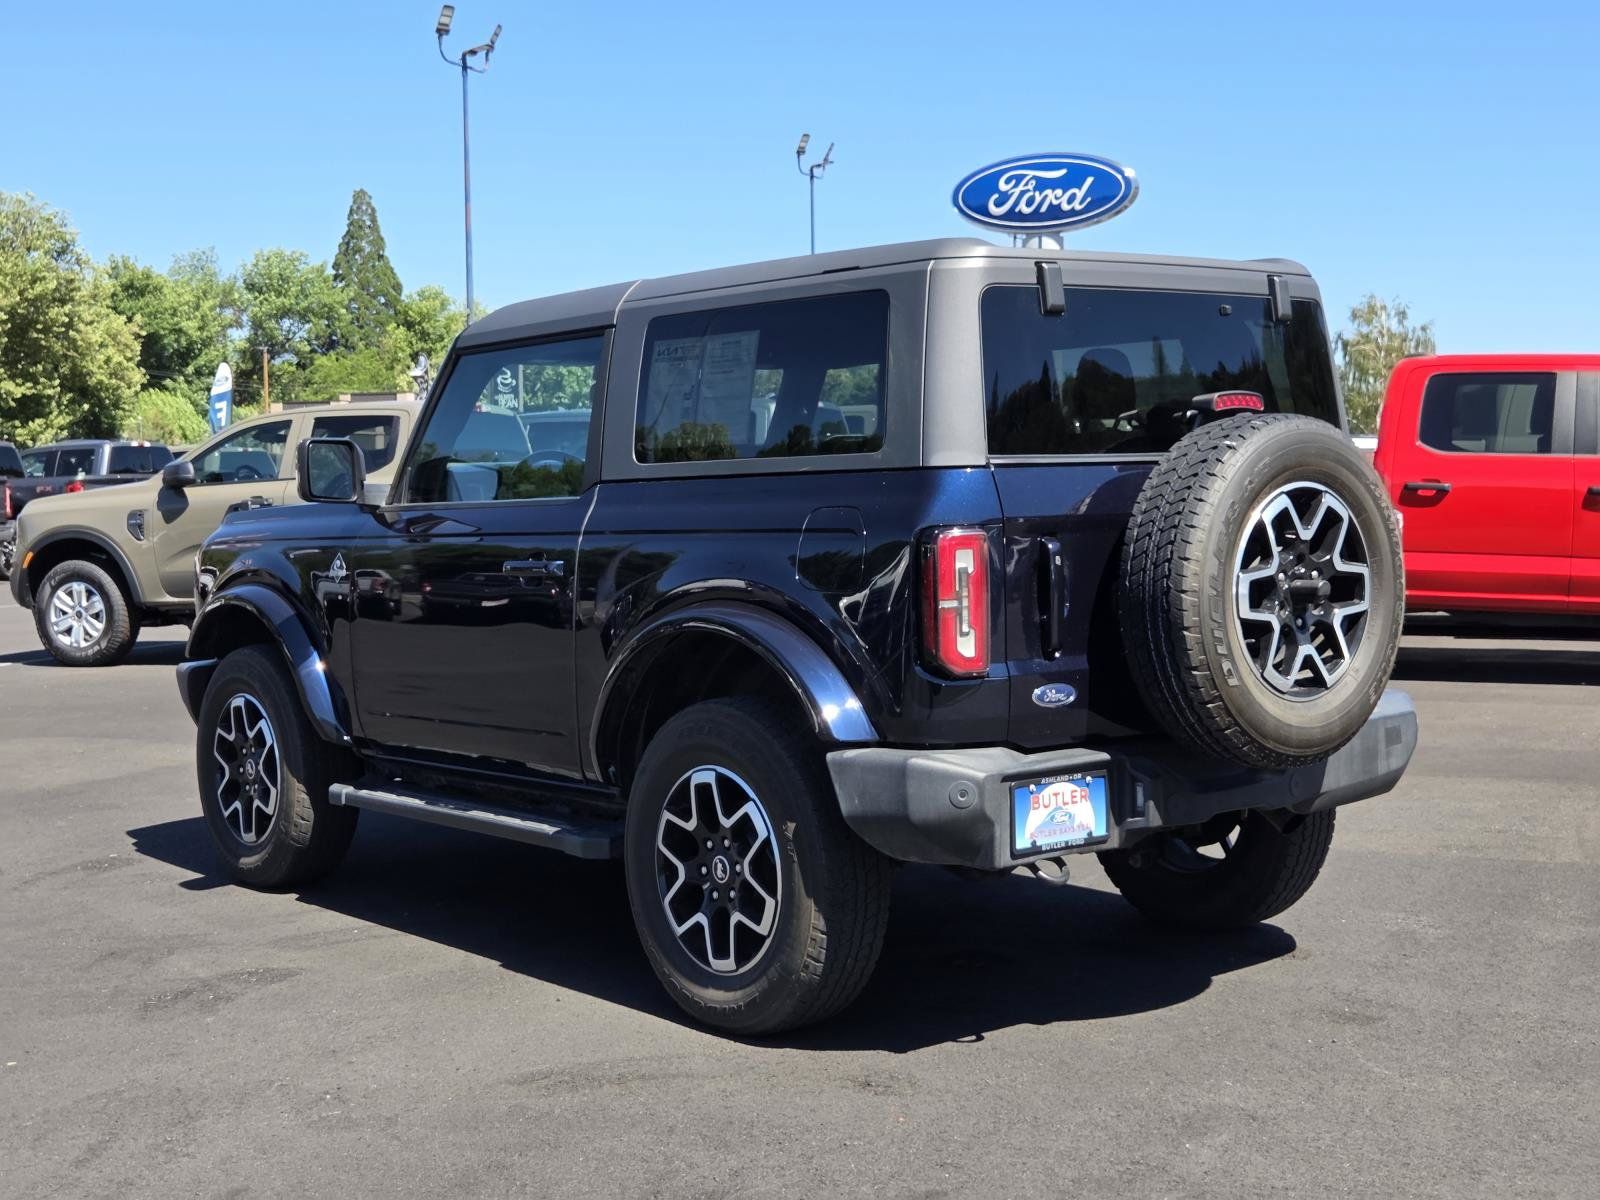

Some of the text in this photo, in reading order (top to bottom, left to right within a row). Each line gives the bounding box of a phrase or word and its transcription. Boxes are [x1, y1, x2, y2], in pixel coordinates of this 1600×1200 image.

[988, 168, 1095, 216] Ford
[1044, 689, 1068, 702] Ford
[1041, 776, 1069, 784] ASHLAND
[1032, 789, 1088, 810] BUTLER
[1041, 841, 1066, 851] BUTLER
